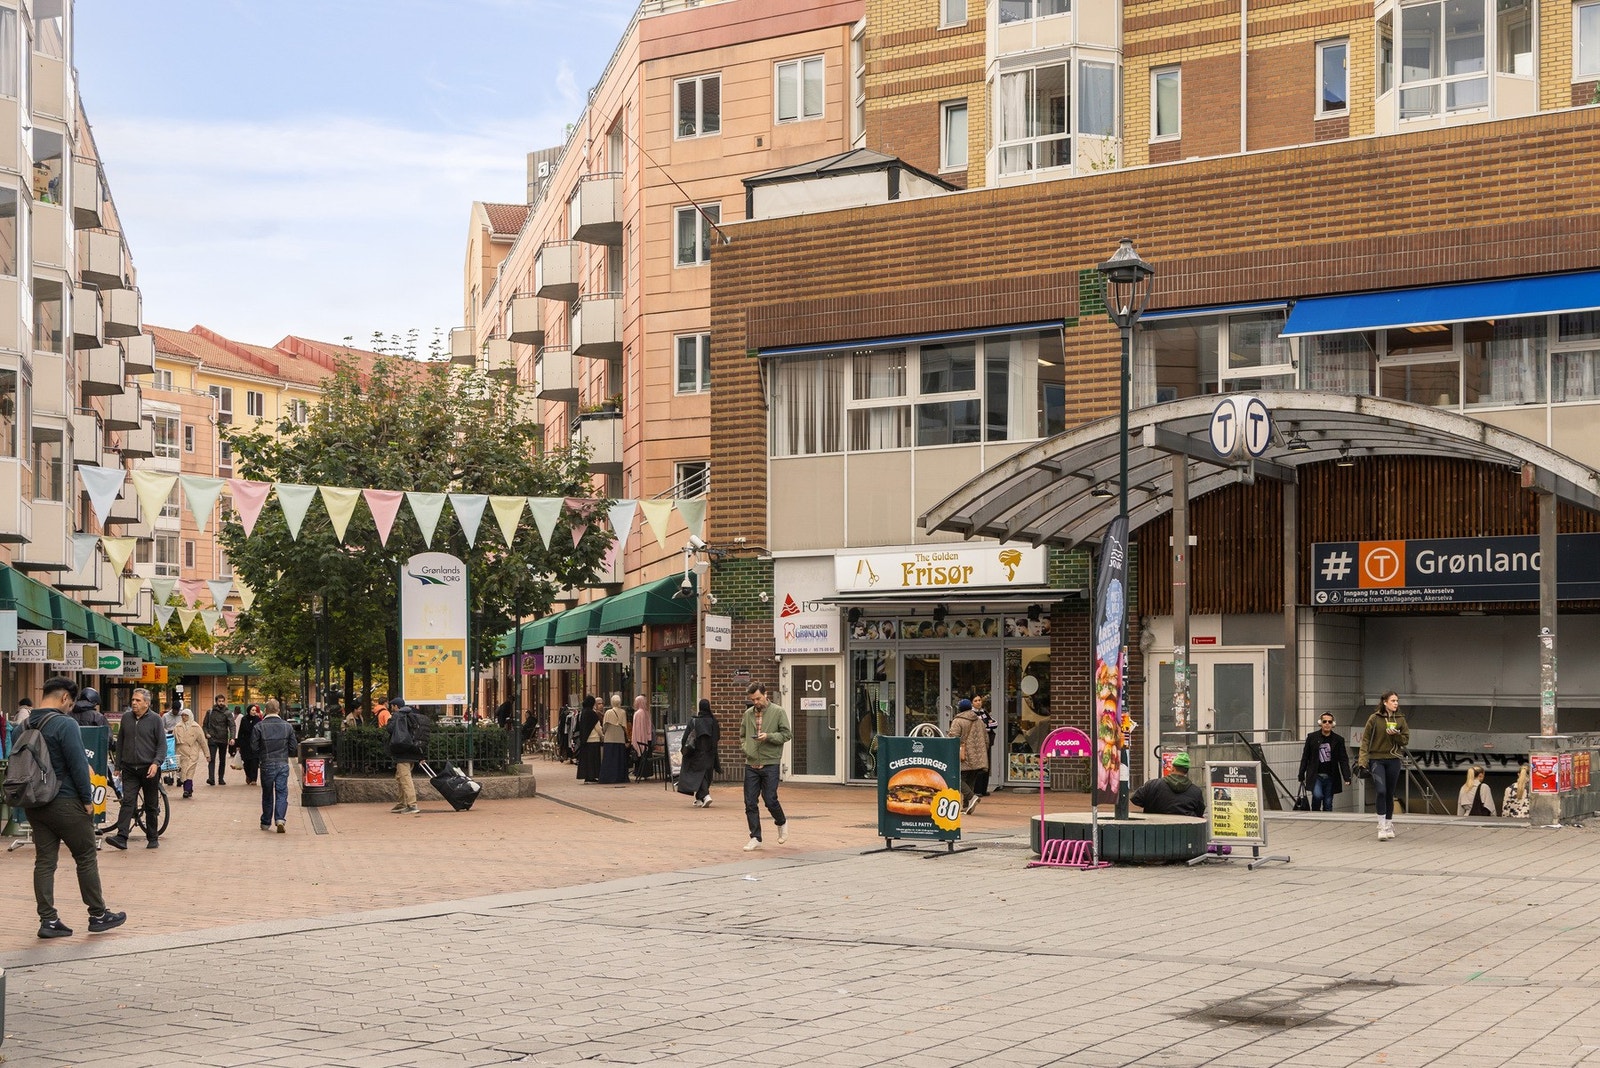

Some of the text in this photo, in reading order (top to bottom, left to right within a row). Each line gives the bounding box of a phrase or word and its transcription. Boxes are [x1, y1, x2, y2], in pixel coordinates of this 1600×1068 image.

[1217, 413, 1232, 448] T
[1250, 412, 1264, 448] T
[915, 551, 959, 562] The Golden
[421, 565, 461, 575] Grønlands
[901, 562, 974, 587] Frisør
[801, 601, 819, 613] FO
[805, 679, 822, 692] FO
[1055, 739, 1080, 747] foodora
[889, 756, 948, 772] CHEESEBURGER
[936, 797, 960, 821] 80
